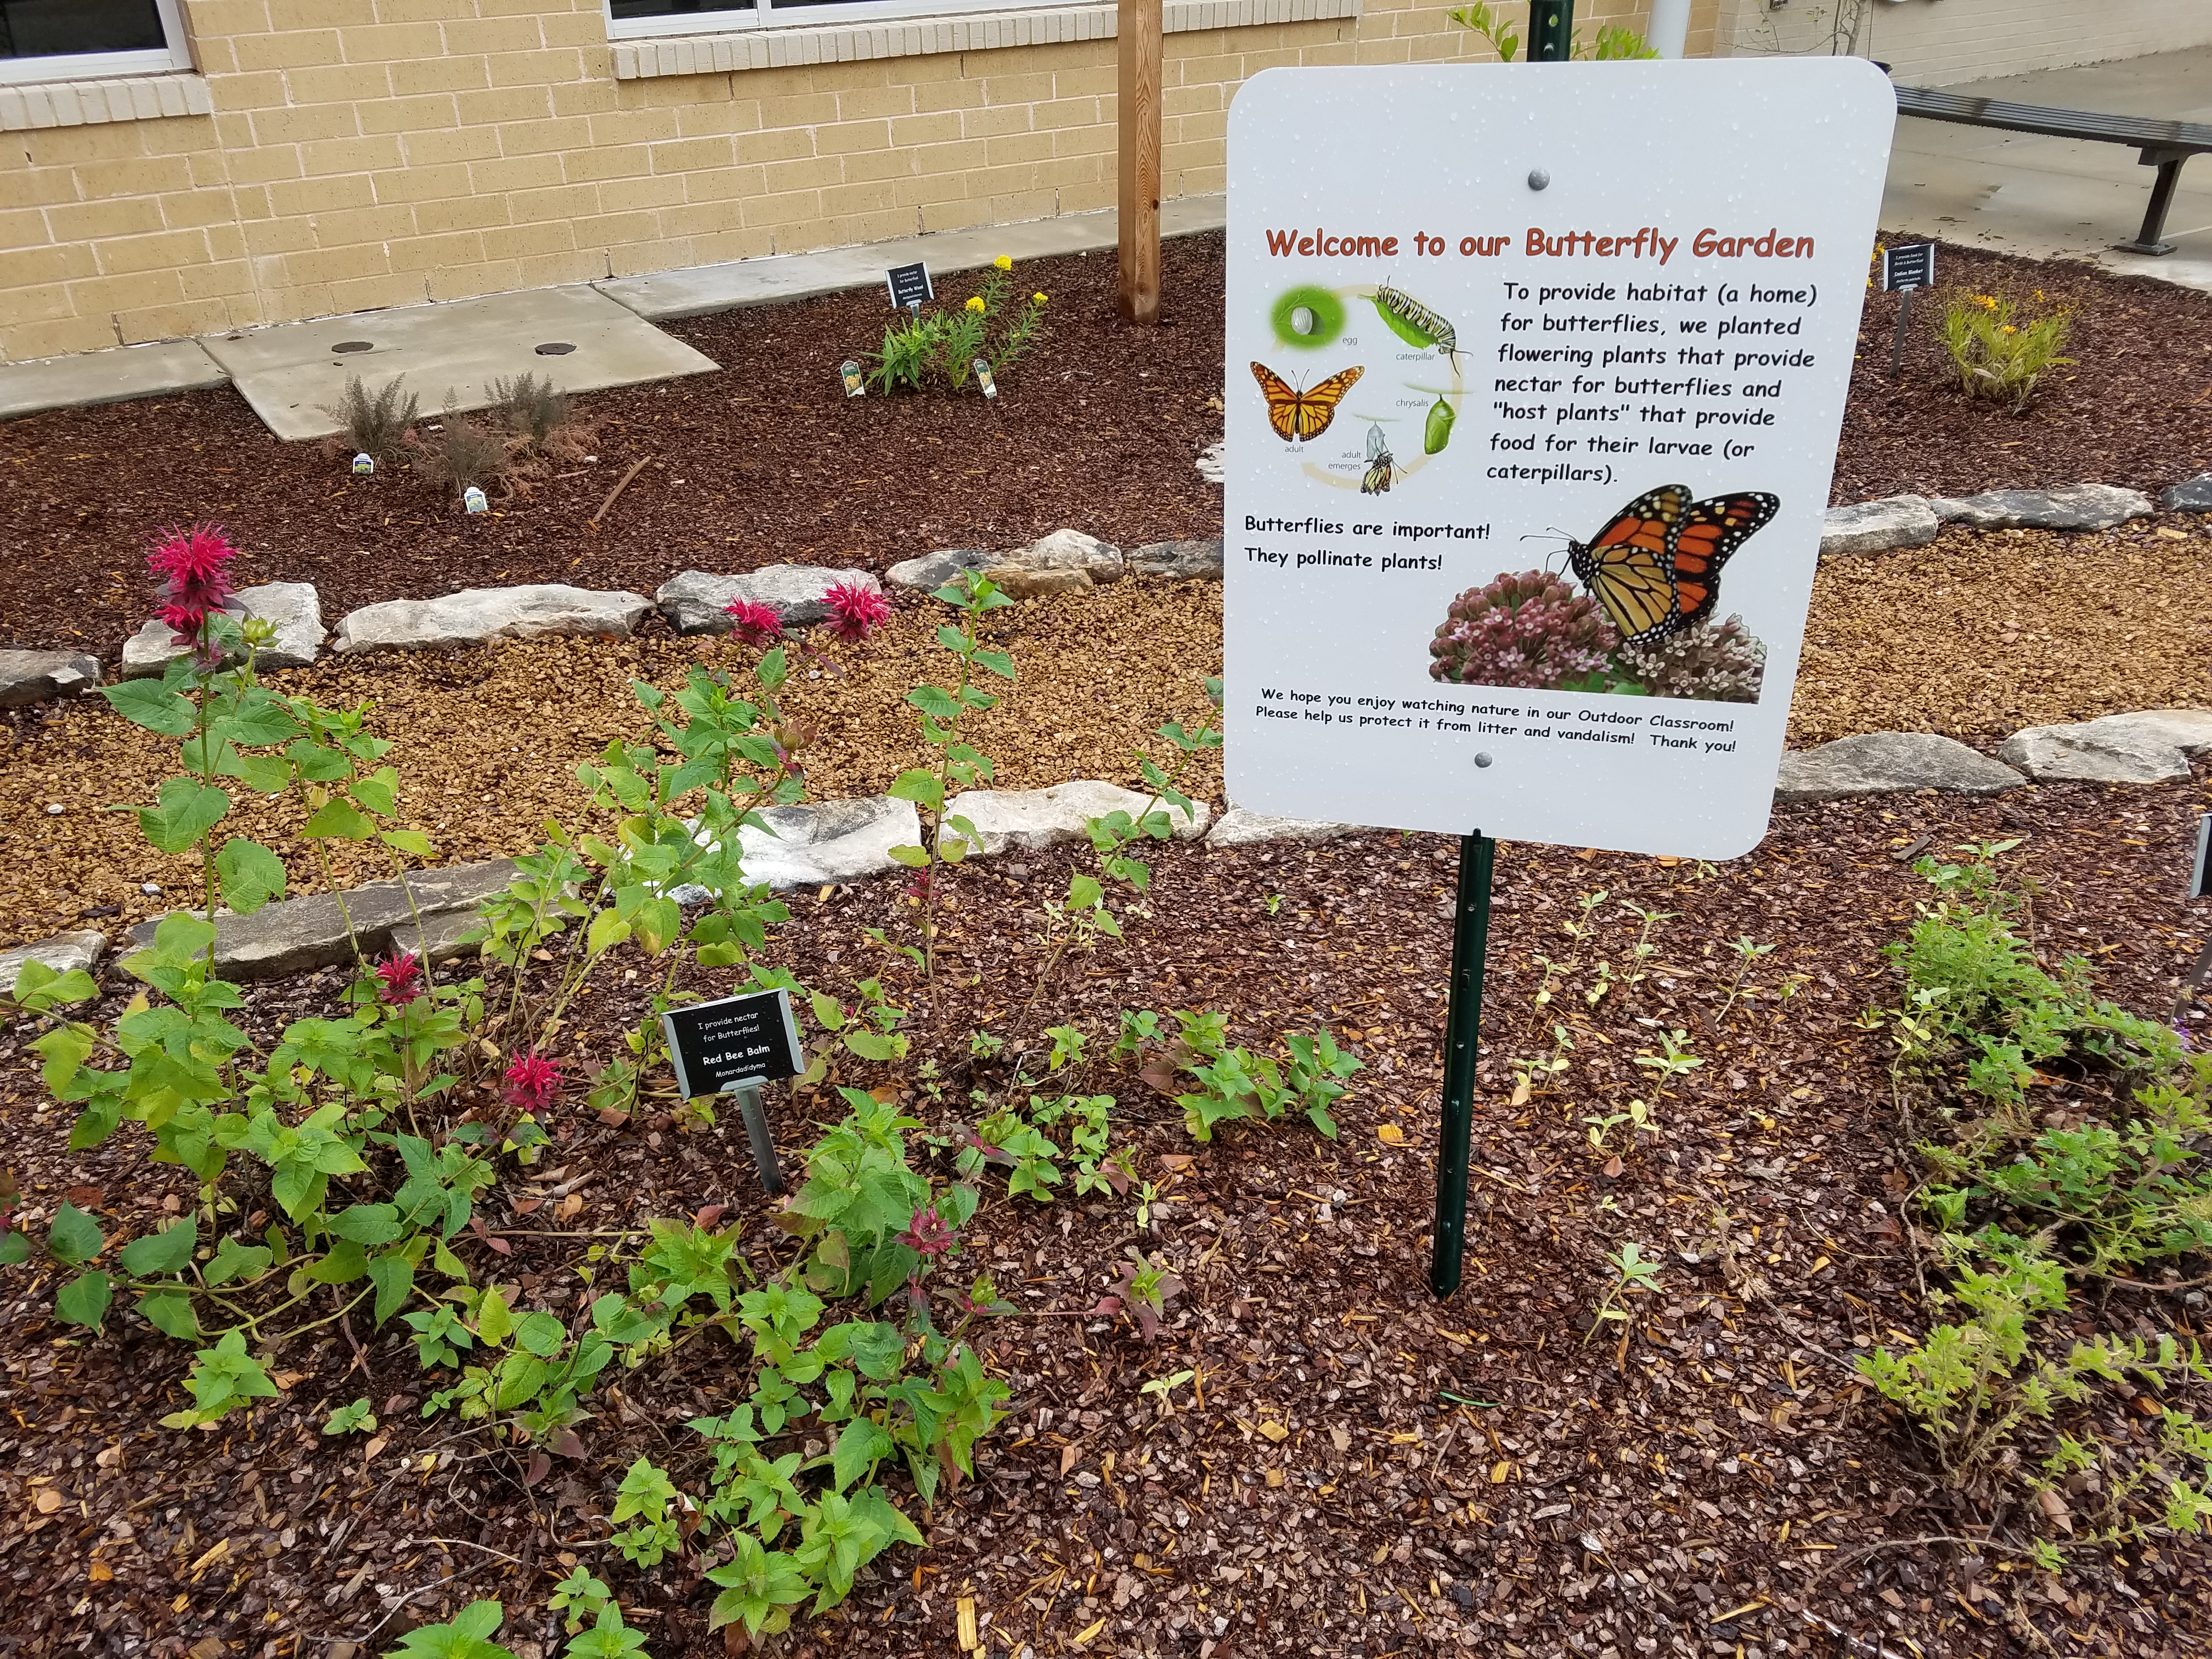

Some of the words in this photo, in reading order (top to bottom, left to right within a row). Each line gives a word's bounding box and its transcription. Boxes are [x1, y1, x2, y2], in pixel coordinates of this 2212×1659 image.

[1266, 228, 1398, 257] Welcome
[1414, 231, 1445, 256] to
[1460, 236, 1510, 256] our
[1526, 228, 1678, 266] Butterfly
[1693, 228, 1814, 258] Garden
[1504, 283, 1528, 299] To
[1539, 283, 1615, 305] provide
[1627, 283, 1708, 301] habitat
[1718, 283, 1738, 306] (a
[1750, 284, 1816, 307] home)
[1501, 313, 1533, 331] for
[1543, 313, 1665, 335] butterflies,
[1680, 321, 1707, 333] we
[1718, 316, 1801, 340] planted
[1396, 352, 1435, 362] caterpillar
[1498, 343, 1593, 368] flowering
[1603, 345, 1666, 368] plants
[1678, 347, 1724, 365] that
[1734, 349, 1814, 371] provide
[1495, 377, 1562, 392] nectar
[1572, 375, 1605, 393] for
[1615, 376, 1731, 396] butterflies
[1743, 380, 1781, 397] and
[1396, 399, 1428, 408] chrysalis
[1494, 402, 1547, 419] "host
[1557, 403, 1629, 425] plants"
[1640, 405, 1686, 422] that
[1696, 408, 1775, 428] provide
[1490, 433, 1535, 450] food
[1545, 434, 1577, 452] for
[1588, 435, 1638, 453] their
[1649, 437, 1712, 455] larvae
[1724, 439, 1754, 460] (or
[1487, 464, 1617, 484] caterpillars).
[1246, 516, 1343, 534] Butterflies
[1353, 524, 1383, 535] are
[1393, 522, 1489, 541] important!
[1244, 548, 1288, 567] They
[1297, 550, 1372, 568] pollinate
[1382, 553, 1441, 572] plants!
[1262, 689, 1283, 699] We
[1291, 690, 1321, 704] hope
[1328, 696, 1351, 706] you
[1358, 696, 1395, 710] enjoy
[1402, 699, 1464, 714] watching
[1472, 704, 1519, 715] nature
[1528, 707, 1539, 718] in
[1579, 710, 1642, 724] Outdoor
[1650, 715, 1734, 731] Classroom!
[1256, 706, 1297, 719] Please
[1305, 709, 1332, 724] help
[1360, 716, 1412, 727] protect
[1419, 718, 1430, 728] it
[1437, 719, 1470, 732] from
[1479, 721, 1517, 735] litter
[1525, 726, 1550, 737] and
[1558, 730, 1634, 744] vandalism!
[1650, 735, 1697, 748] Thank
[1705, 741, 1736, 753] you!
[705, 1017, 732, 1030] provide
[735, 1013, 758, 1022] nectar
[718, 1024, 760, 1040] Butterflies!
[703, 1054, 722, 1065] Red
[725, 1052, 743, 1060] Bee
[747, 1045, 770, 1056] Balm
[716, 1063, 765, 1077] Monardadidyma
